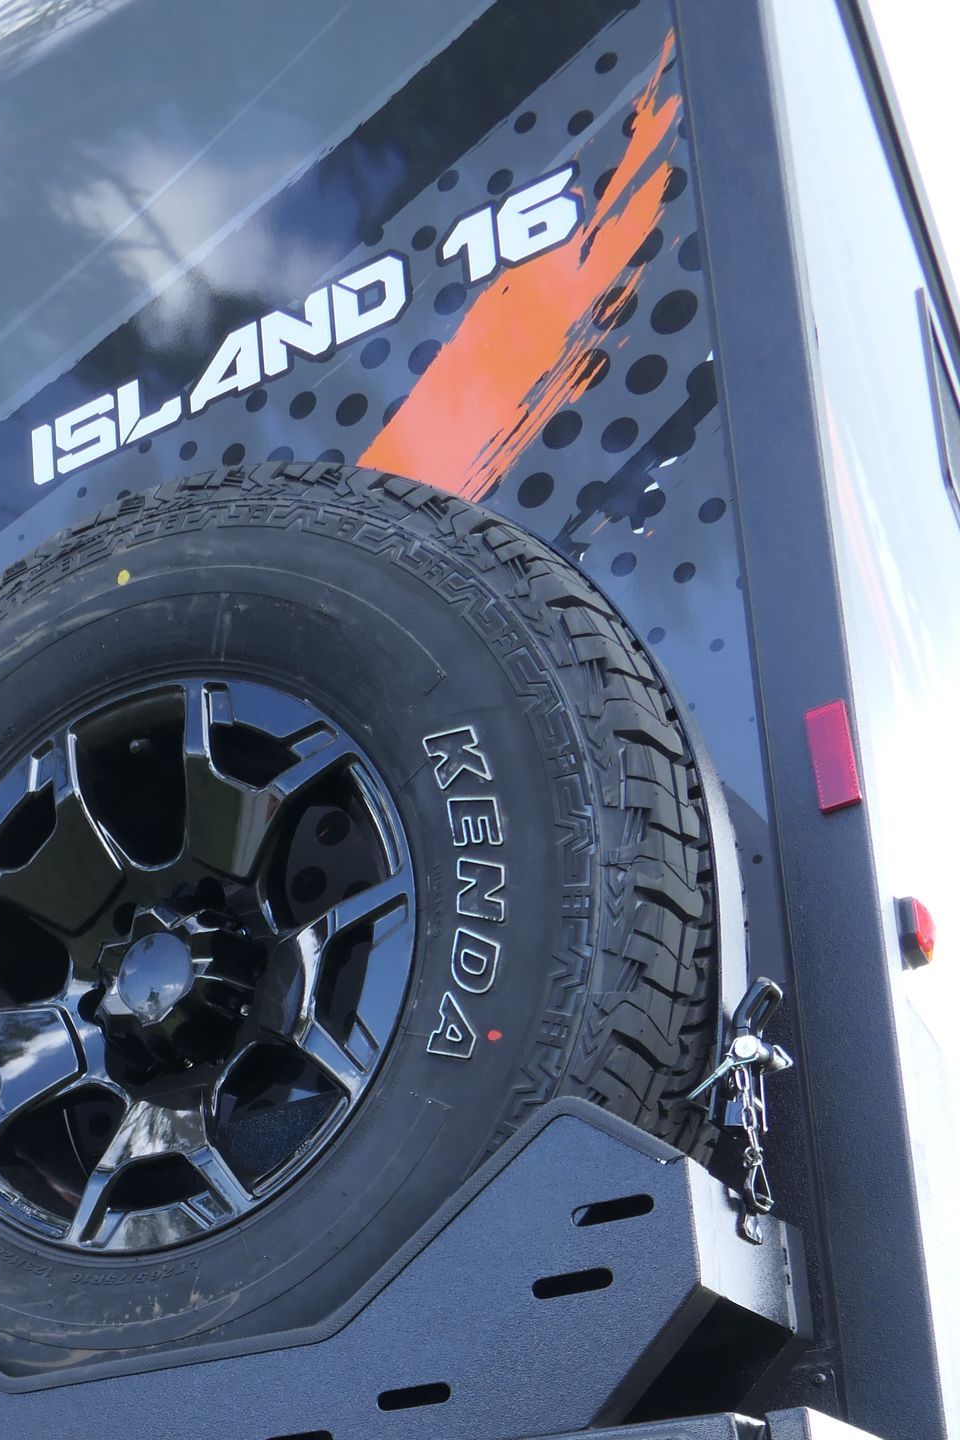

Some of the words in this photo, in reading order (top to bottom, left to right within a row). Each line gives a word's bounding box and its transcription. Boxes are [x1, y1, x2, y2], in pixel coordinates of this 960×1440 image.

[30, 254, 407, 486] ISLAND
[441, 166, 580, 283] 16
[422, 725, 506, 1060] KENDA
